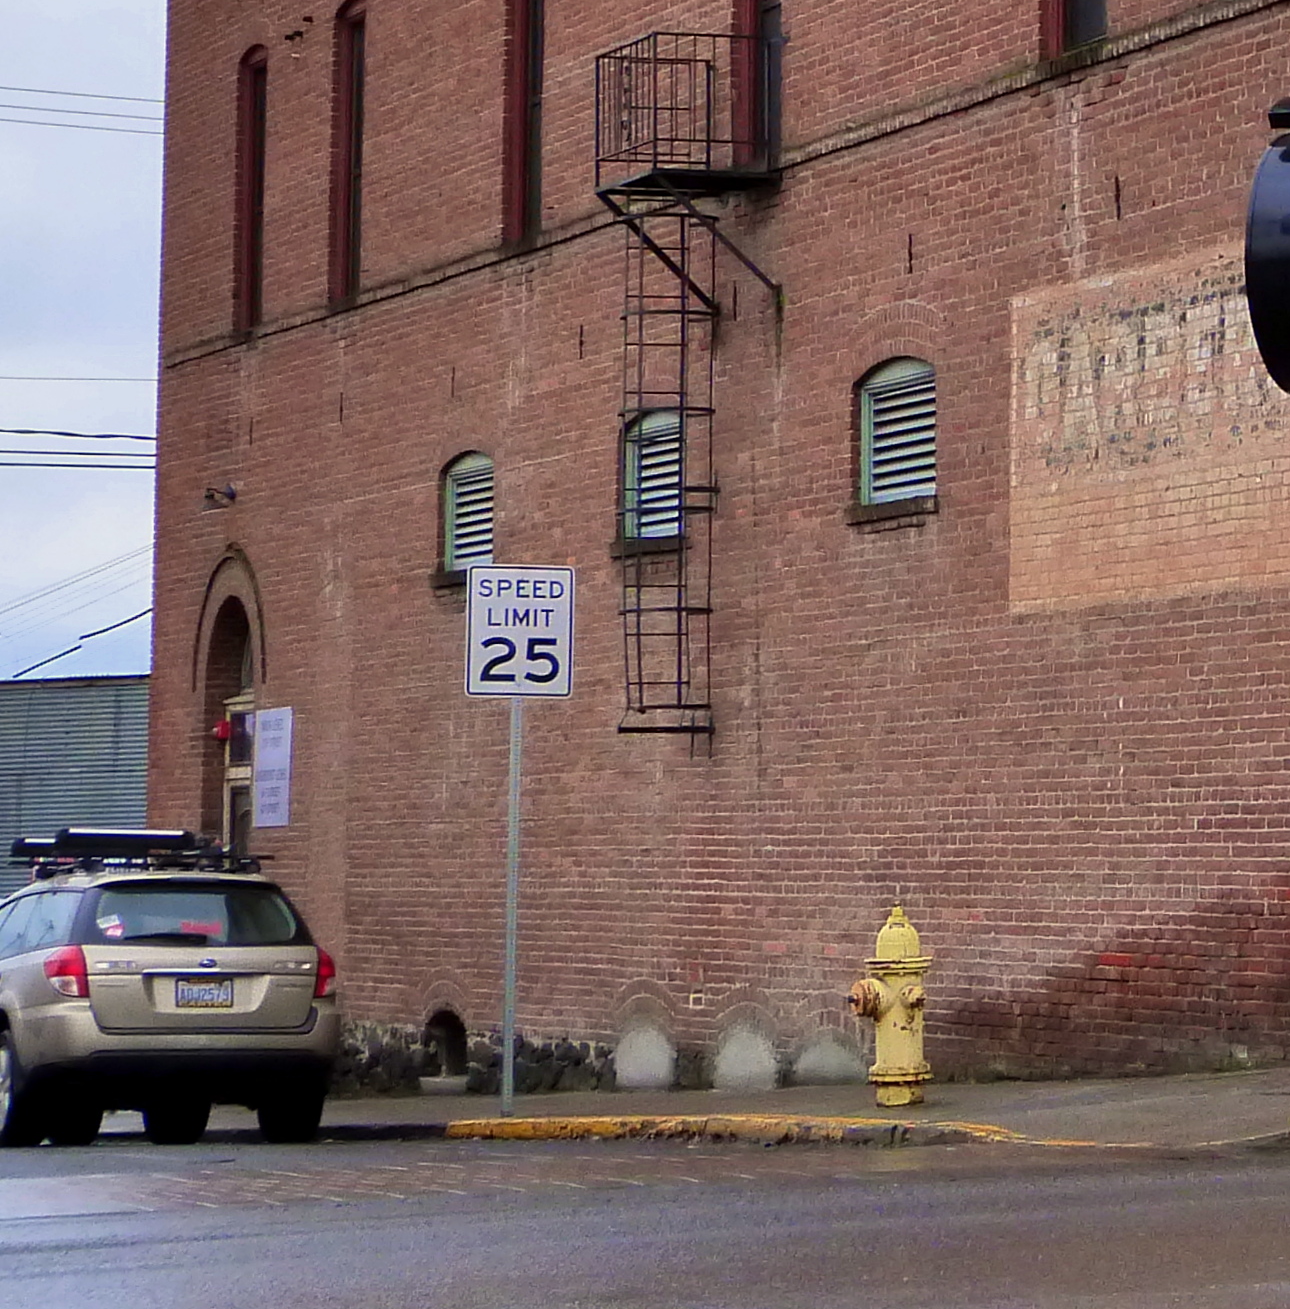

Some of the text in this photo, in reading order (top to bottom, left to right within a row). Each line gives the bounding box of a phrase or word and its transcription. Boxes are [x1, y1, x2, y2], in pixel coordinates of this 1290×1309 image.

[479, 578, 565, 600] SPEED
[487, 607, 555, 628] LIMIT
[479, 636, 561, 684] 25
